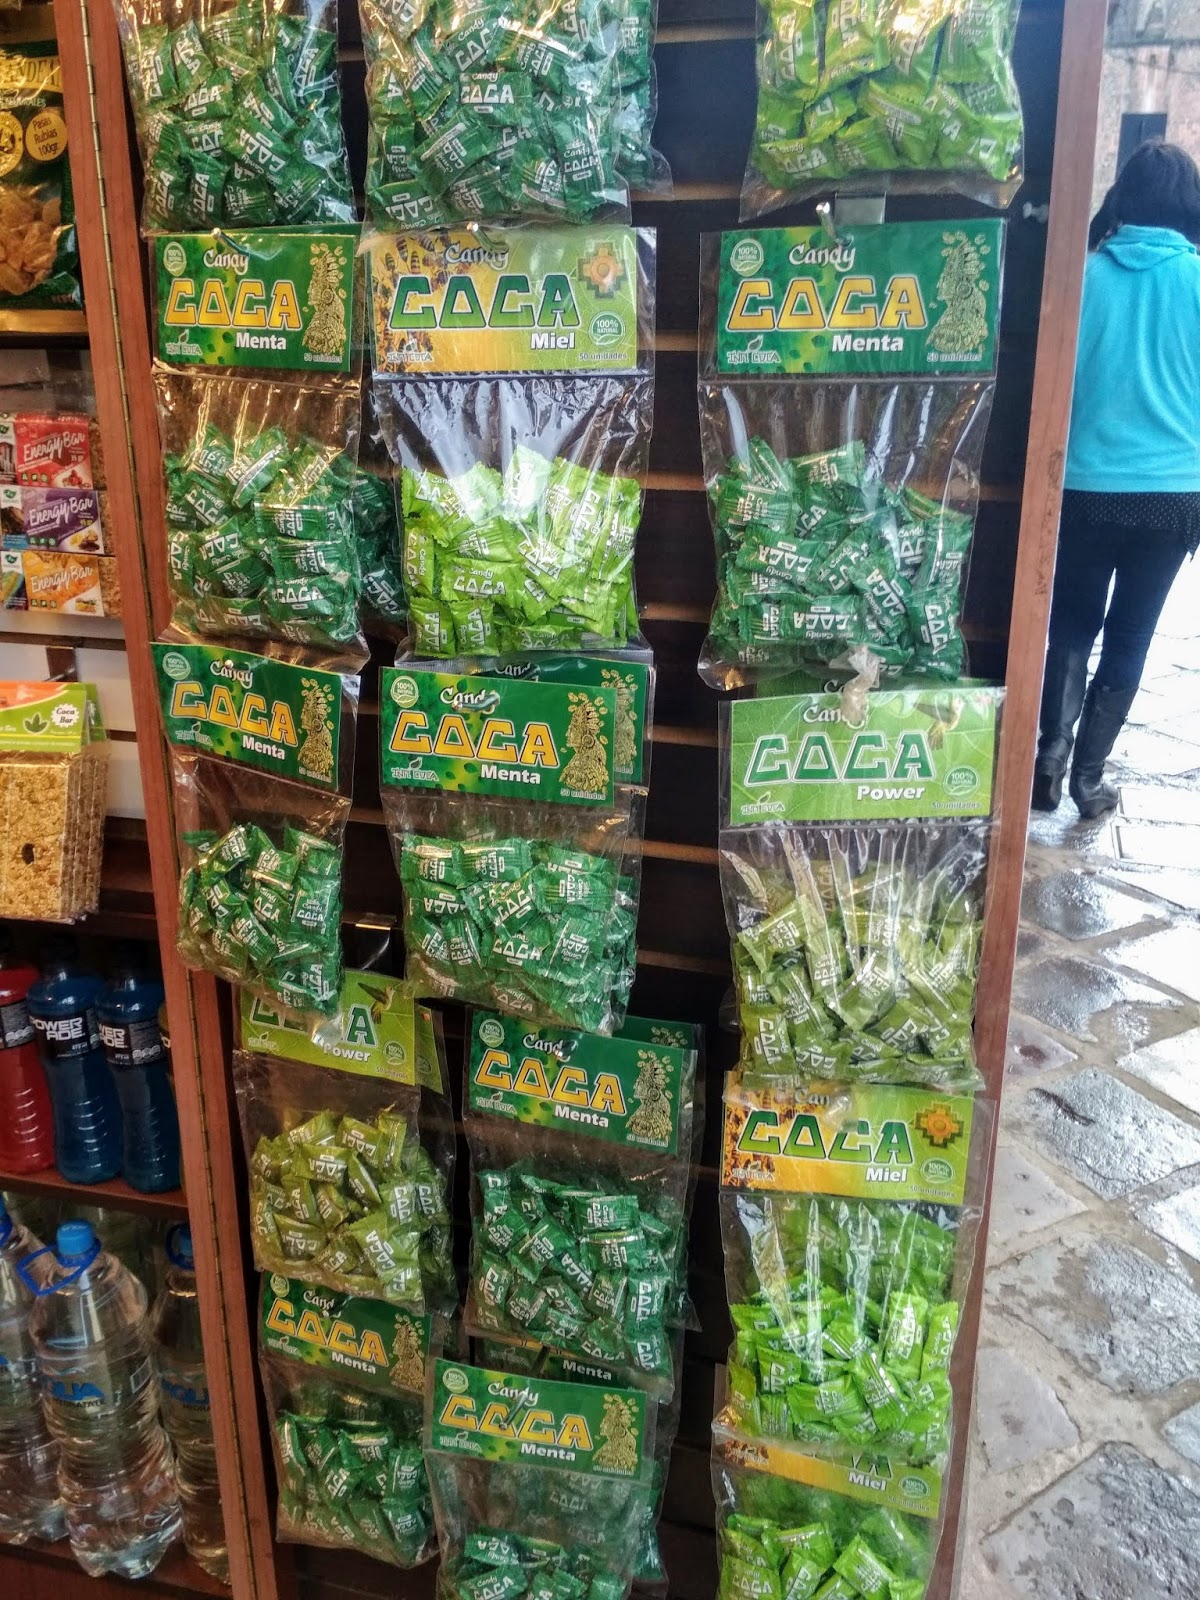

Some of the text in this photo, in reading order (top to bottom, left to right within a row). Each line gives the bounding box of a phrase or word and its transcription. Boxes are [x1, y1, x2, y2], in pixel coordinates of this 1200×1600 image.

[460, 84, 515, 105] COCA
[564, 158, 601, 173] COCA
[788, 241, 855, 272] Candy
[164, 278, 302, 330] COCA
[389, 273, 582, 330] COCA
[726, 274, 928, 331] COCA
[595, 319, 619, 328] 100%
[236, 332, 287, 350] Menta
[531, 333, 575, 350] Miel
[832, 334, 903, 353] Menta
[579, 351, 627, 361] 50 unidades
[759, 546, 813, 573] COCA
[453, 577, 506, 596] COCA
[793, 613, 851, 630] COCA
[396, 682, 413, 690] 100%
[56, 707, 75, 715] Coca
[170, 680, 298, 747] COCA
[804, 705, 869, 729] Can
[242, 735, 286, 760] Menta
[389, 710, 560, 769] COCA
[745, 731, 935, 786] COCA
[481, 764, 541, 785] Menta
[951, 772, 973, 781] 100%
[857, 786, 925, 801] Power
[250, 996, 378, 1048] CA
[46, 1028, 84, 1041] ADE
[474, 1048, 627, 1116] COCA
[794, 1088, 830, 1105] Can
[554, 1104, 609, 1128] Menta
[737, 1109, 914, 1164] COCA
[866, 1168, 907, 1182] Miel
[266, 1296, 389, 1368] COCA
[331, 1352, 376, 1374] Menta
[562, 1360, 612, 1381] Menta
[439, 1394, 593, 1451] COCA
[521, 1442, 576, 1462] Menta
[848, 1472, 887, 1491] Miel
